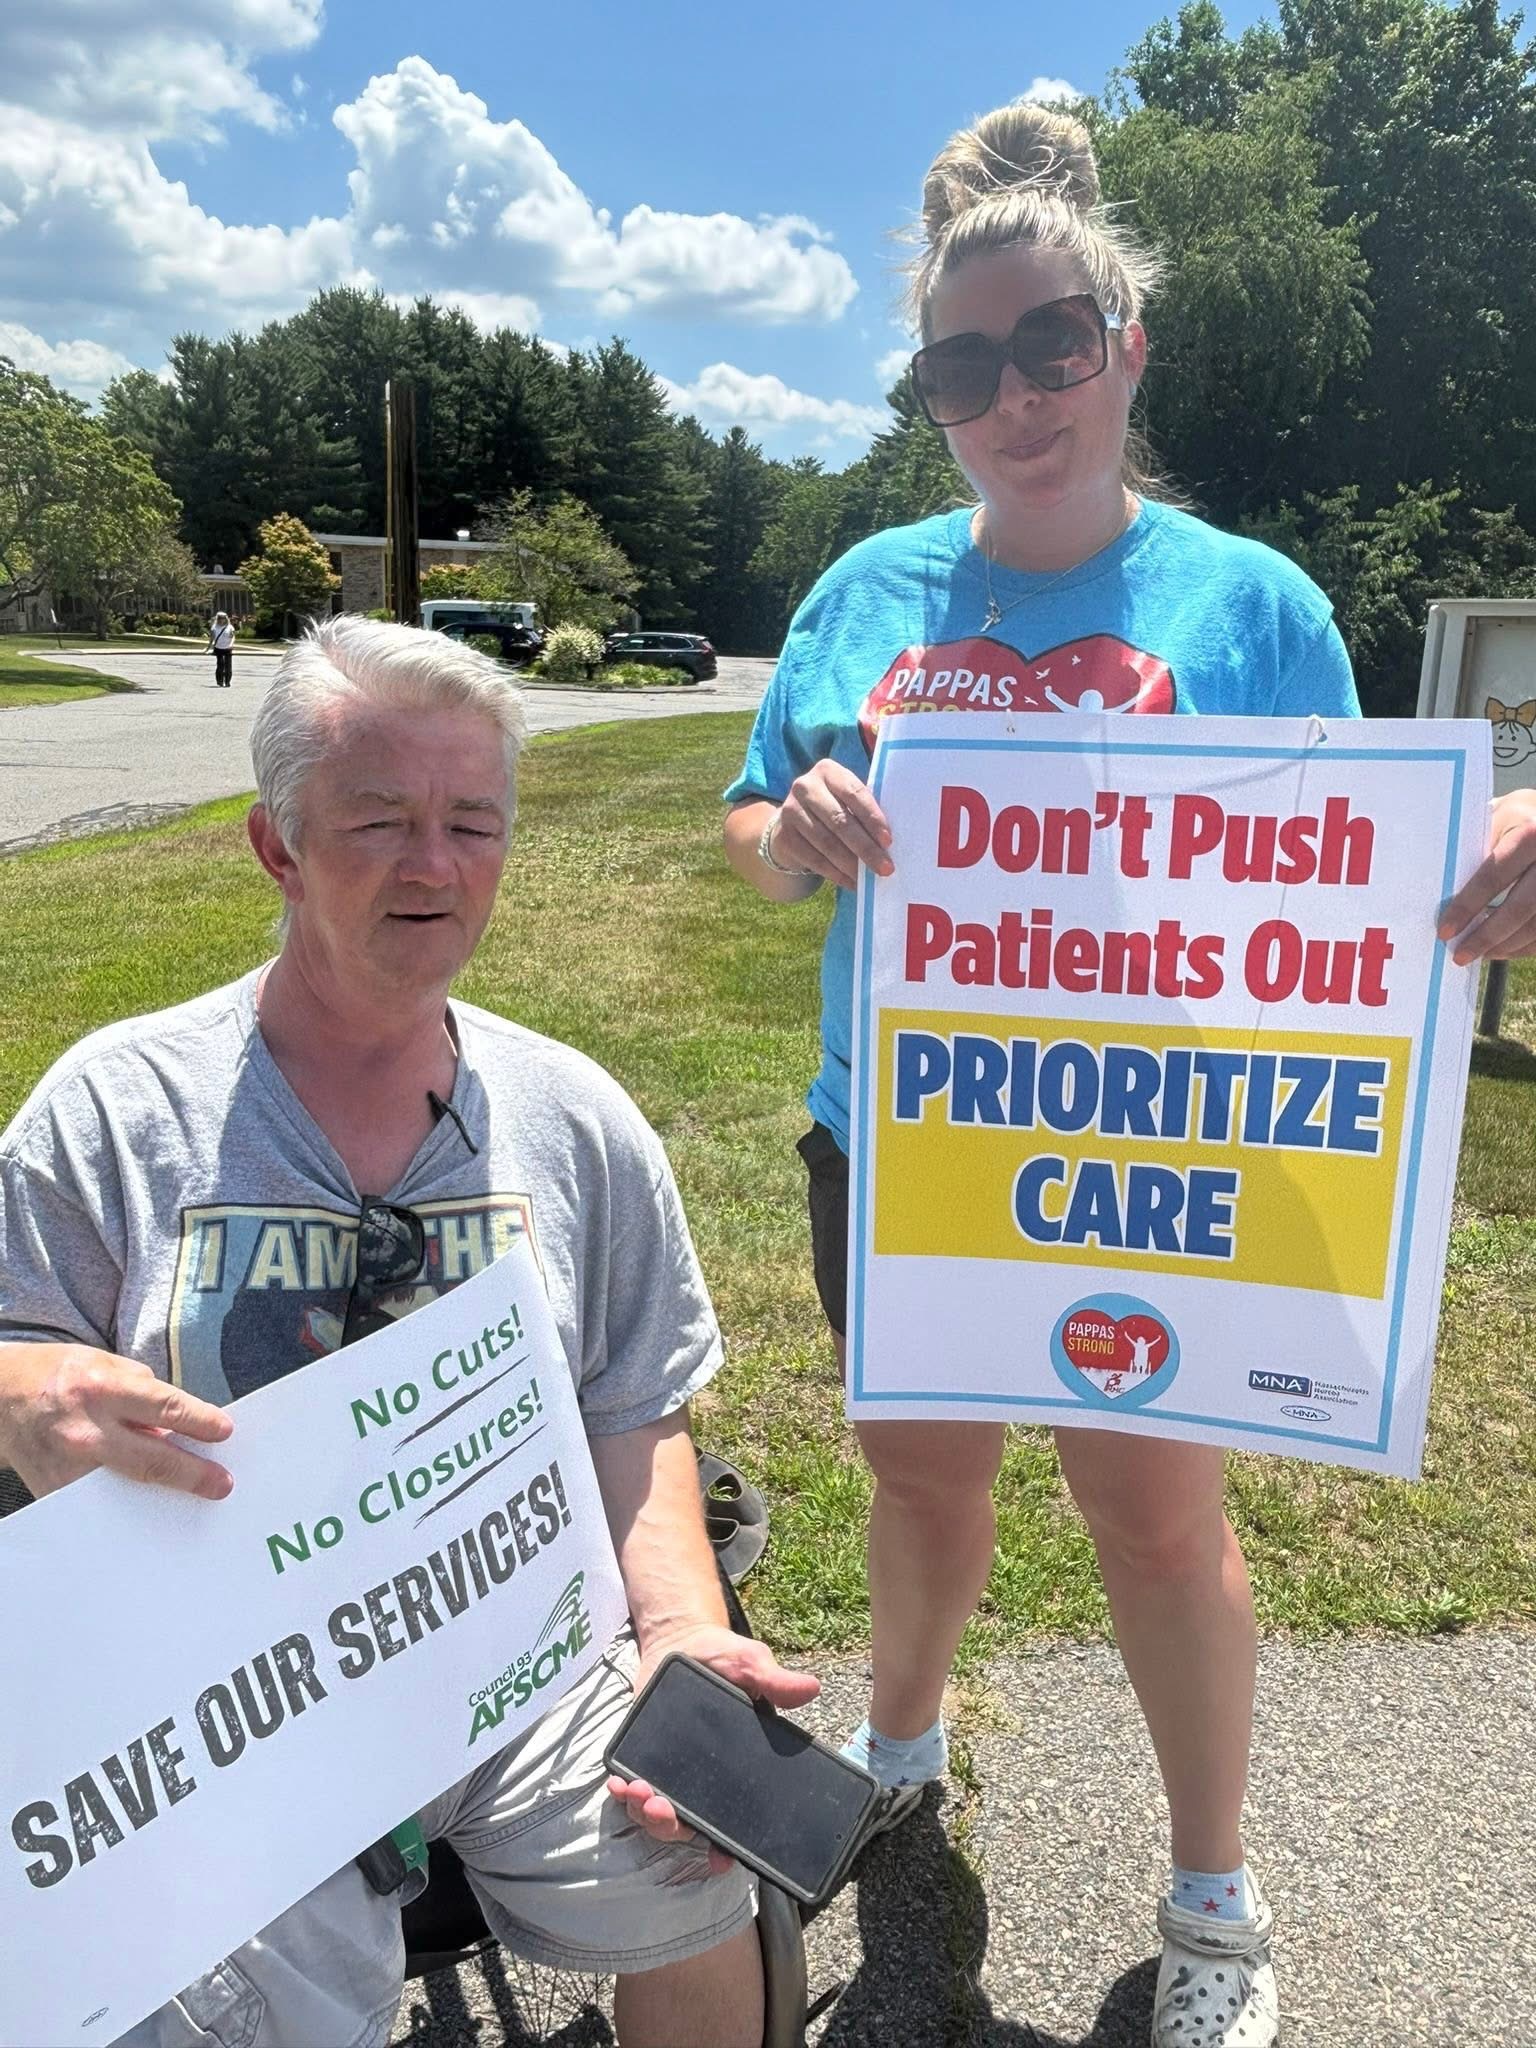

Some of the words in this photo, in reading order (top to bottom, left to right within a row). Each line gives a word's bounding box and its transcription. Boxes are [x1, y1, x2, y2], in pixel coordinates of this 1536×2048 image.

[886, 668, 1017, 707] PAPPAS
[936, 785, 1153, 879] Don't
[1168, 794, 1375, 885] Push
[905, 902, 1225, 999] Patients
[1244, 919, 1394, 1007] Out
[894, 1031, 1389, 1155] PRIORITIZE
[196, 1219, 227, 1292] I
[247, 1220, 358, 1291] AM
[1014, 1155, 1238, 1259] CARE
[350, 1382, 420, 1439] No
[432, 1303, 524, 1391] Cuts!
[1067, 1337, 1115, 1355] STRONG
[1068, 1322, 1115, 1340] PAPPAS
[1251, 1373, 1302, 1391] MNA
[266, 1515, 344, 1575] No
[358, 1378, 543, 1524] Closures!
[10, 1716, 197, 1889] SAVE
[194, 1632, 328, 1768] OUR
[328, 1460, 573, 1680] SERVICES!
[468, 1609, 593, 1747] AFSCME
[469, 1662, 516, 1707] Council
[517, 1651, 532, 1671] 93
